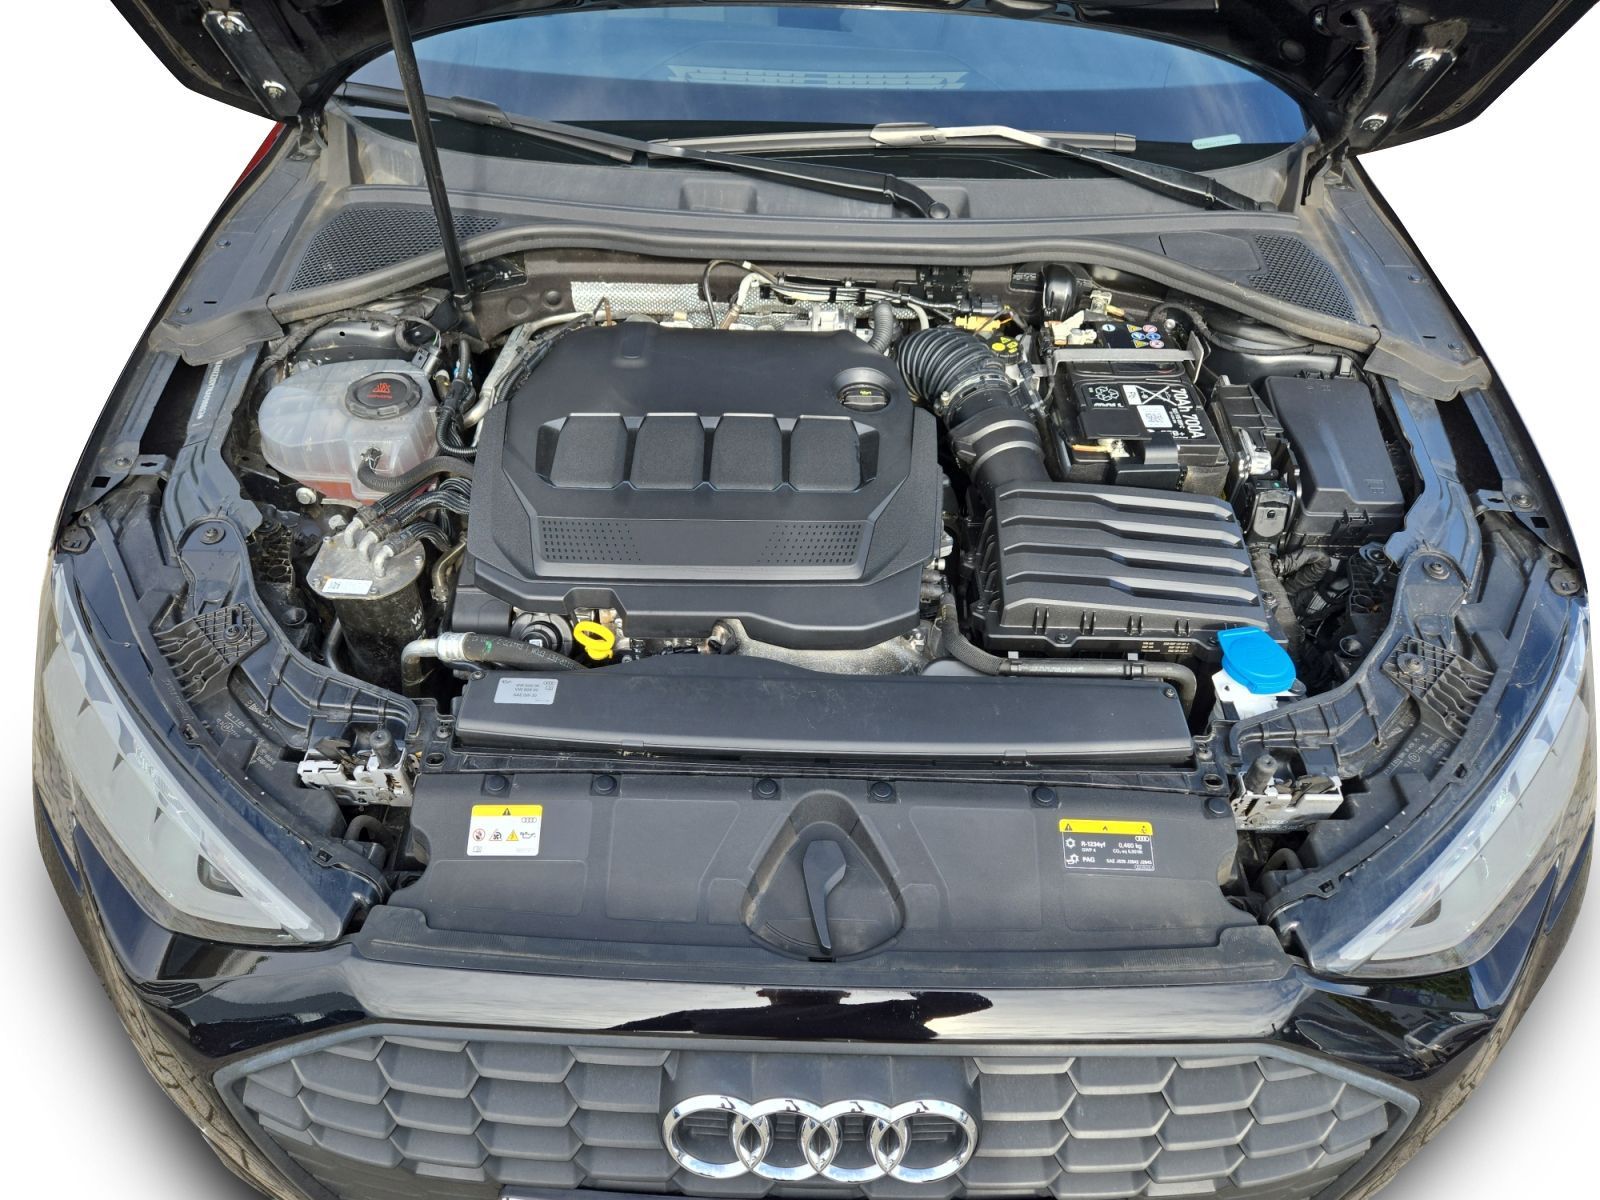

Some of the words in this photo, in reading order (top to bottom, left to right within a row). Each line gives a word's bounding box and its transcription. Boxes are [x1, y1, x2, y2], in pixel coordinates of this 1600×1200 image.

[1171, 388, 1193, 412] 70Ah
[1182, 414, 1206, 438] 700A
[1080, 840, 1106, 849] R-1234yf
